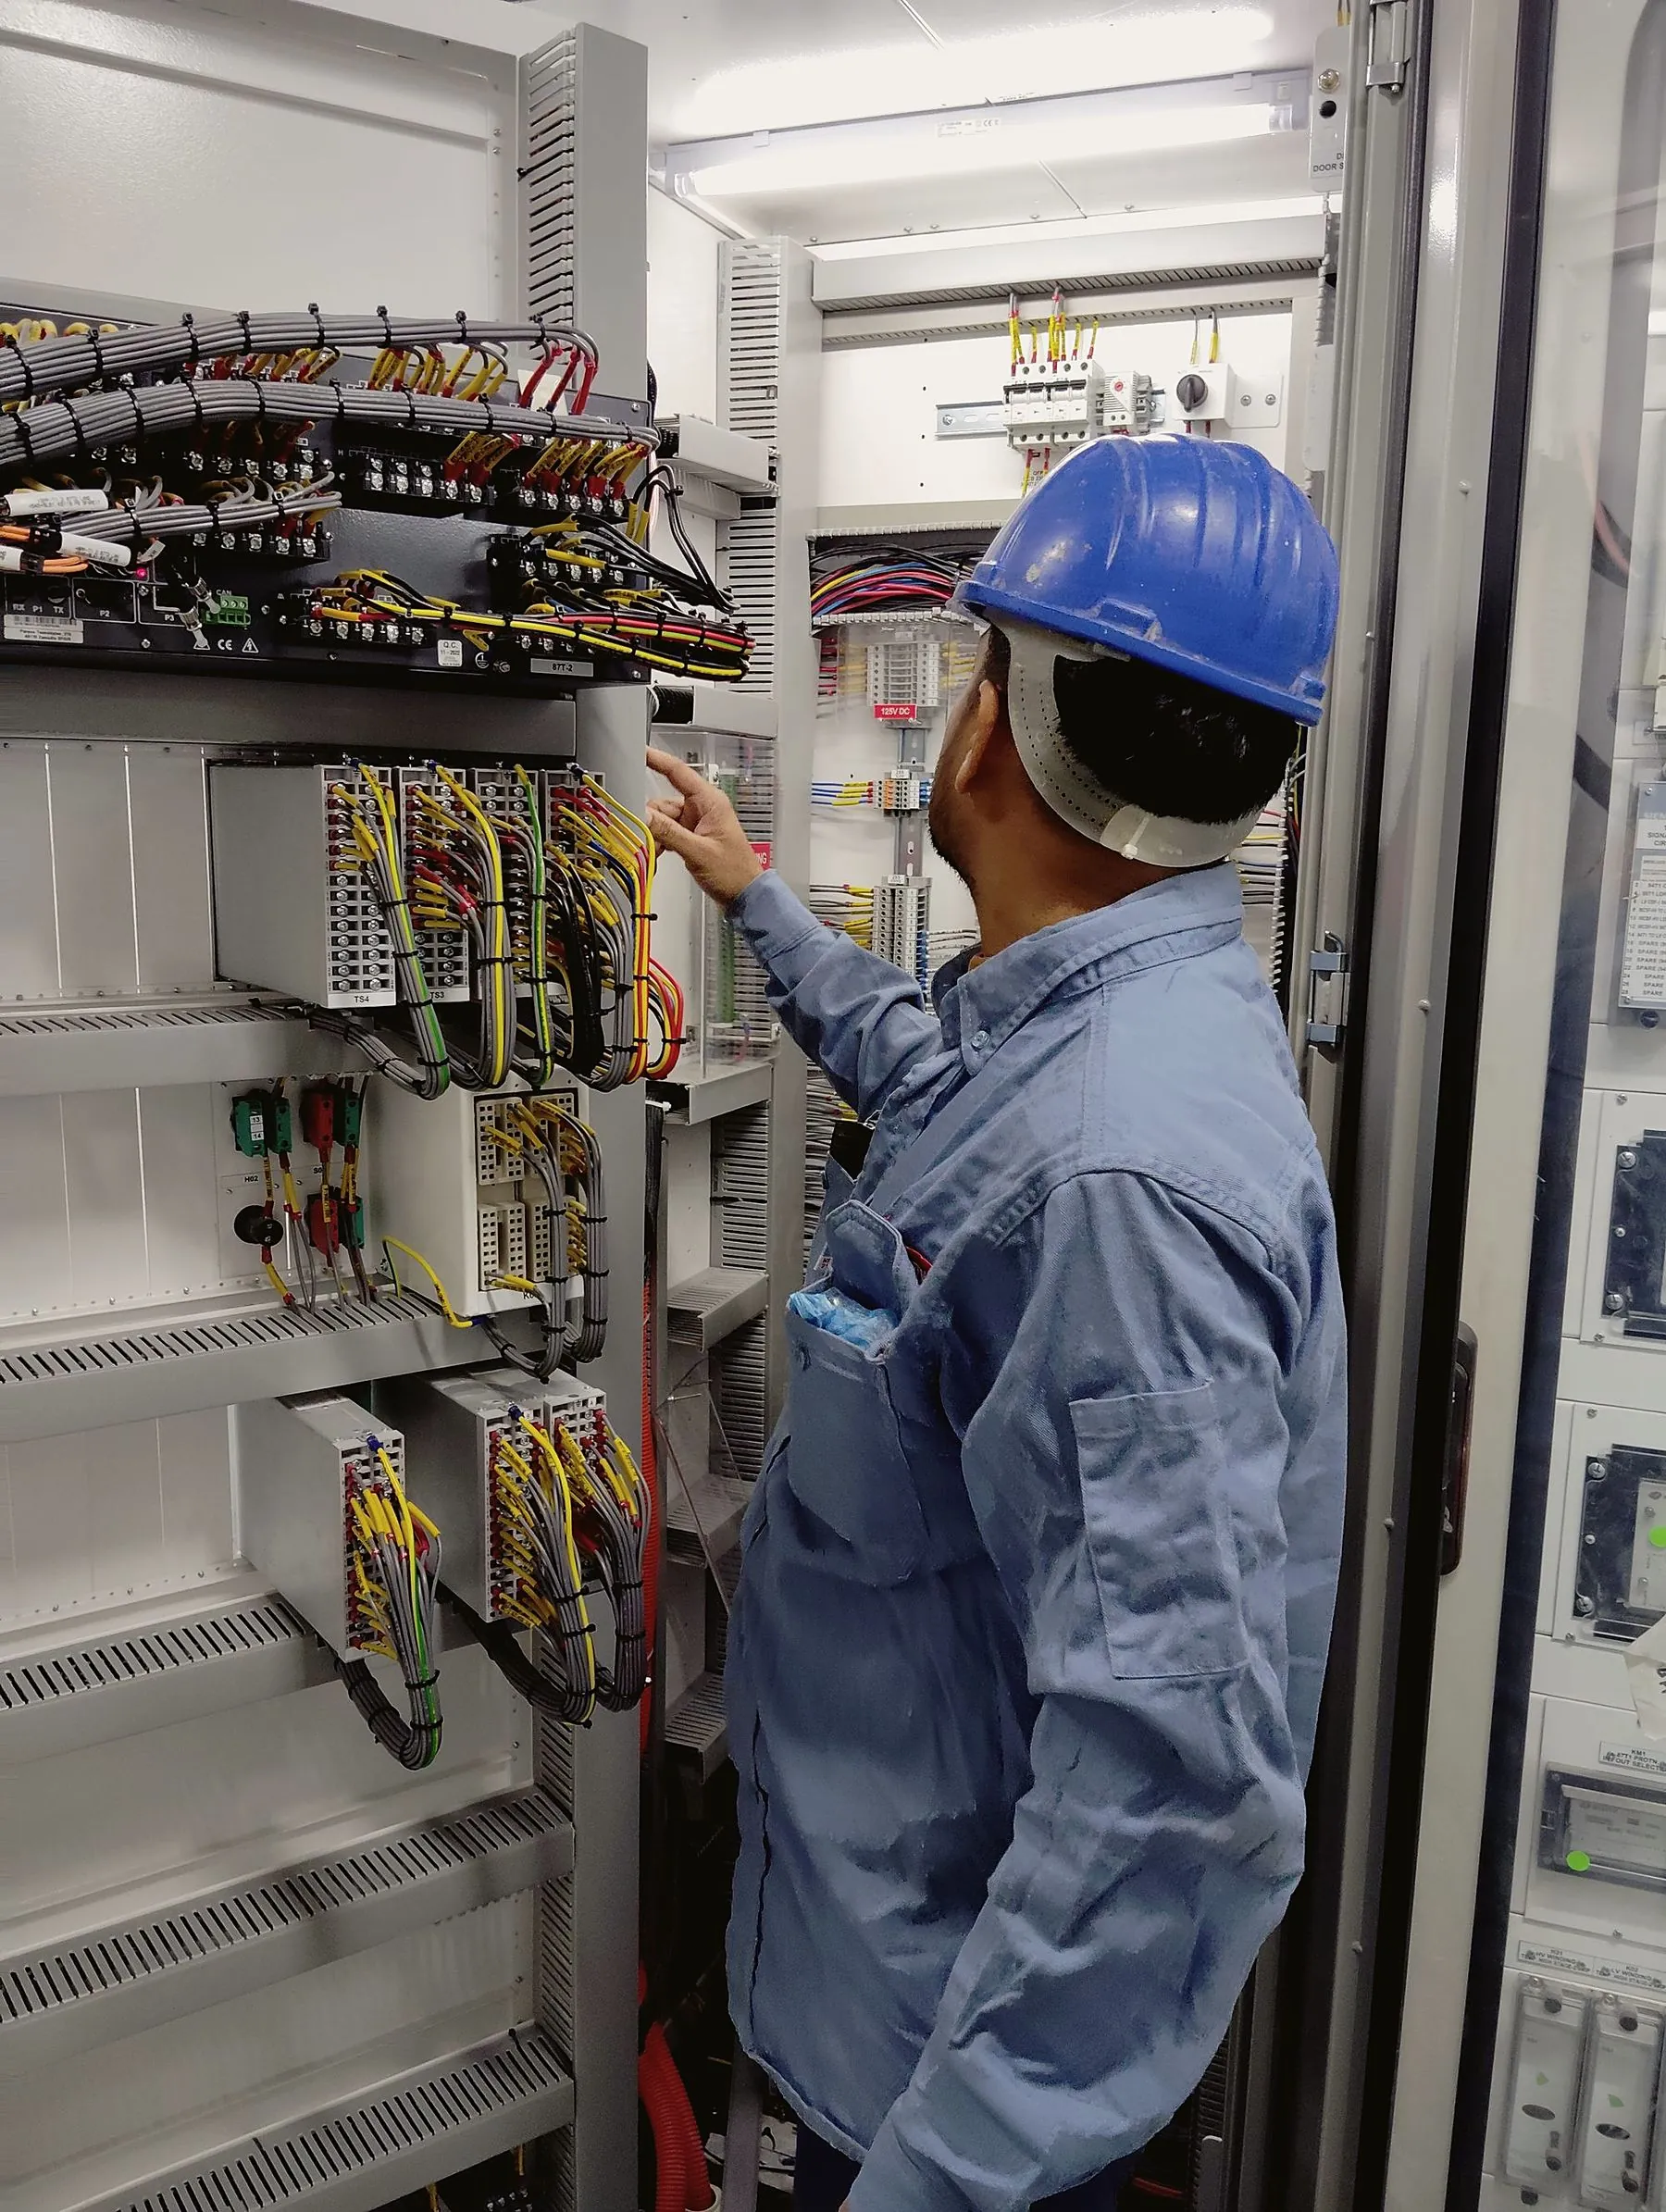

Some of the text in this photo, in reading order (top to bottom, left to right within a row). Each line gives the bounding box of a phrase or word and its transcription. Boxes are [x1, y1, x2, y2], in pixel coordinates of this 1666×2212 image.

[1312, 163, 1337, 172] DOOR
[164, 614, 175, 622] P3
[881, 707, 911, 715] 125V DC
[354, 995, 369, 1003] TS4
